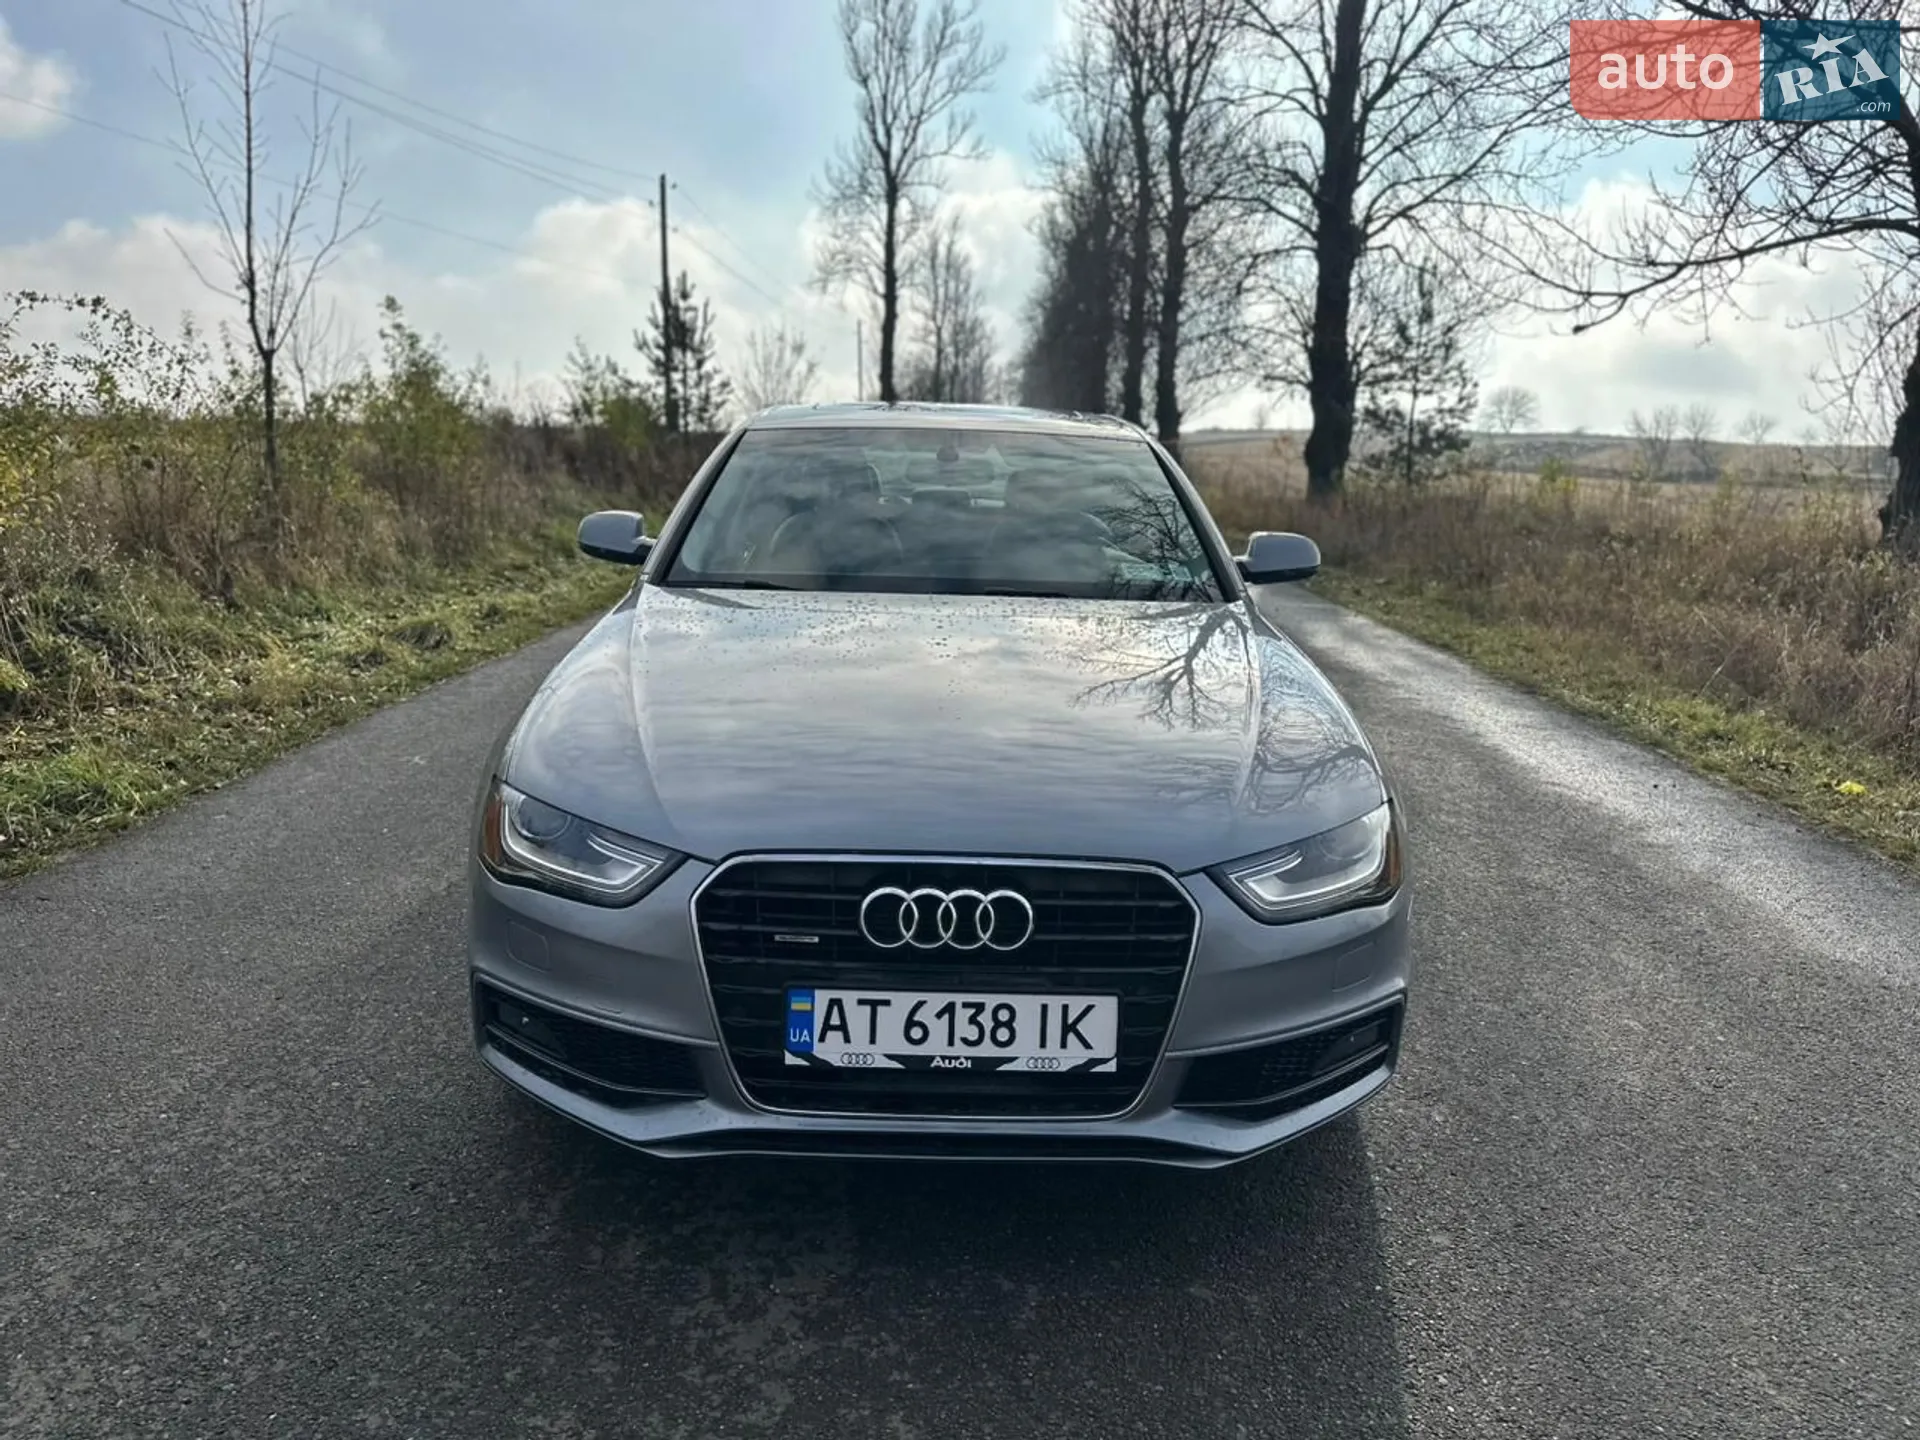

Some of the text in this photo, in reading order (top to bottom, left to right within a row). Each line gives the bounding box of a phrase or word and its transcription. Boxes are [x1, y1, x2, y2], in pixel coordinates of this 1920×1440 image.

[817, 997, 1096, 1051] AT 6138 IK
[790, 1028, 811, 1043] UA
[930, 1055, 972, 1069] Audi
